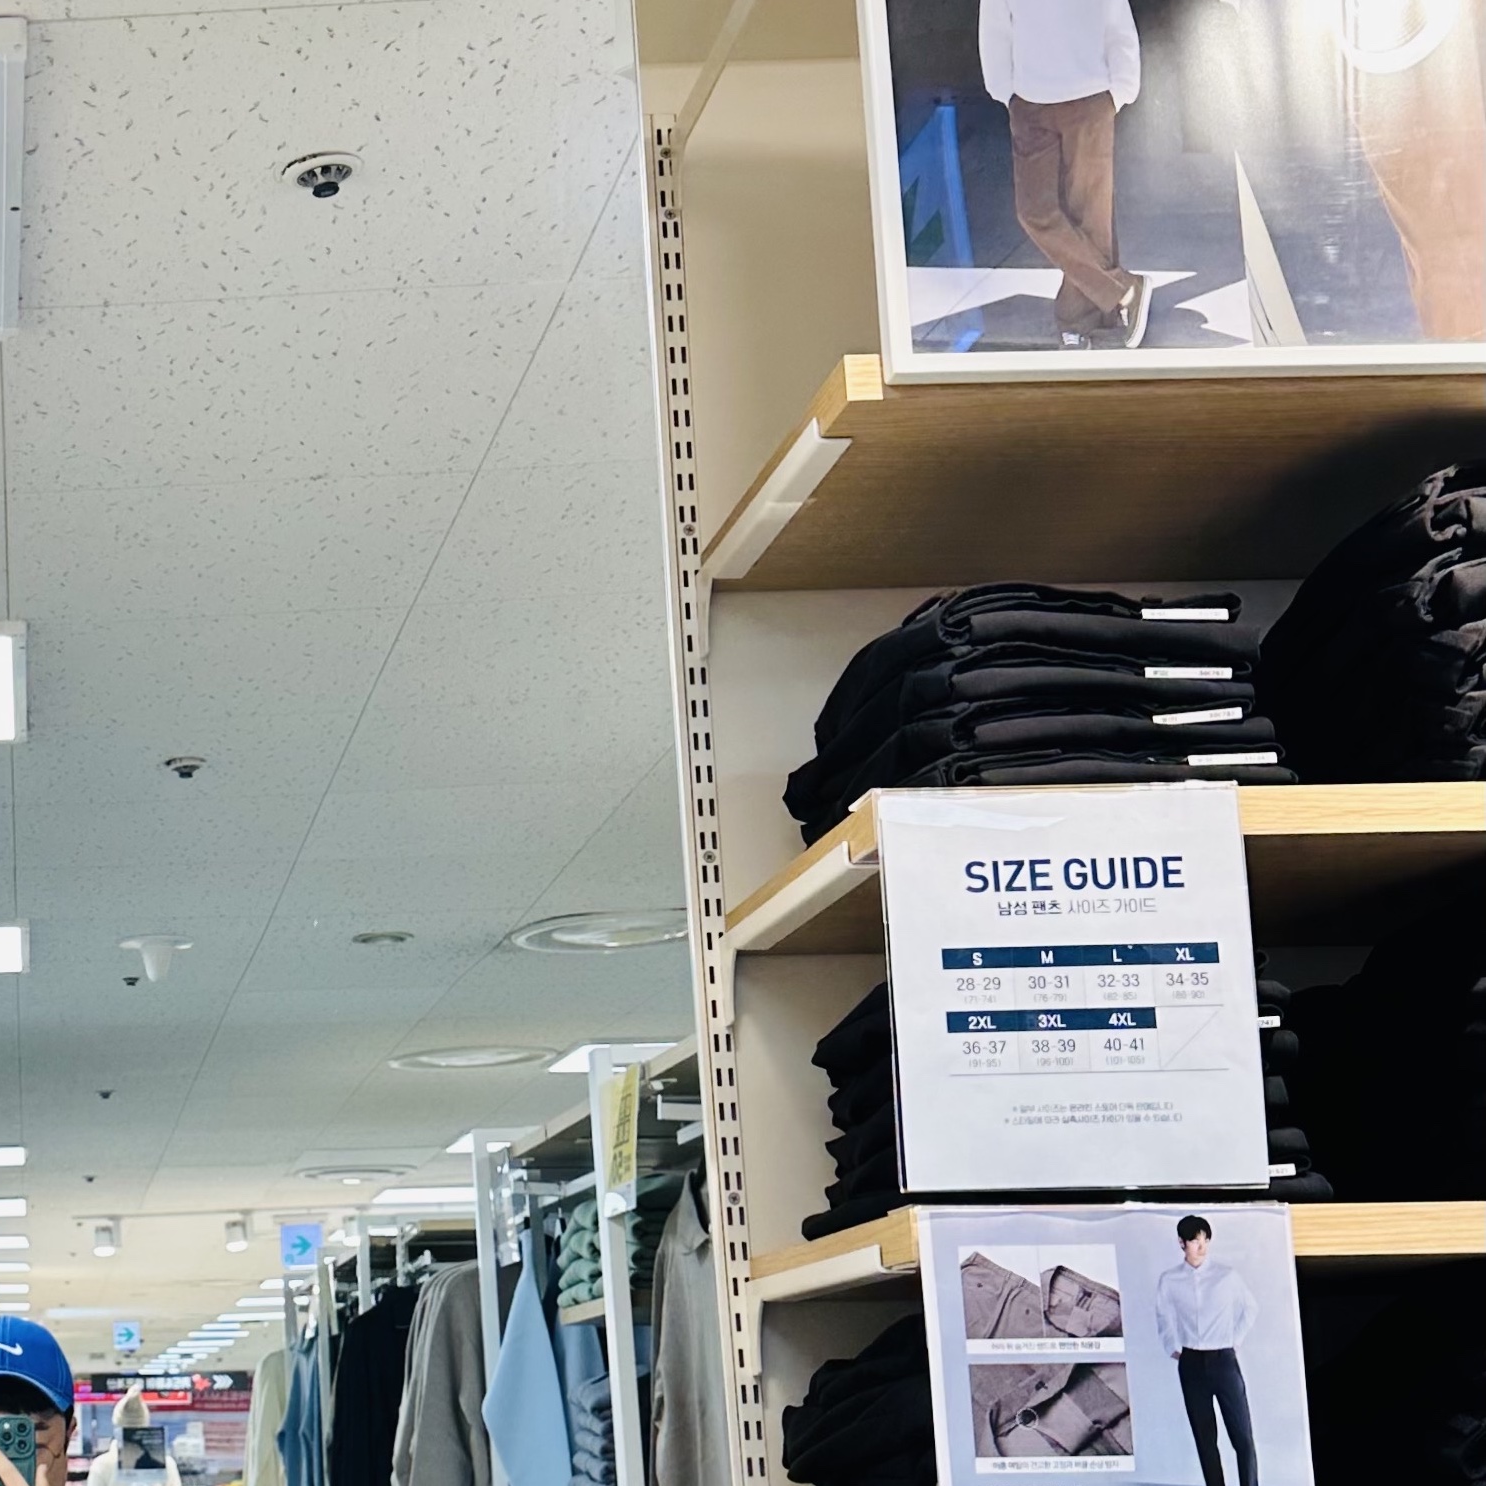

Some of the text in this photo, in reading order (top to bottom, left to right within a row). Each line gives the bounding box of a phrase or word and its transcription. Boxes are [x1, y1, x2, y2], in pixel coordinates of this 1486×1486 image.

[965, 856, 1185, 893] SIZE GUIDE
[998, 898, 1158, 916] 남성 팬츠 사이즈 가이드
[972, 952, 983, 965] S
[1041, 951, 1053, 964] M
[1113, 950, 1122, 962] L
[1176, 948, 1194, 961] XL
[956, 977, 1001, 991] 28-29
[1028, 975, 1070, 989] 30-31
[1097, 974, 1140, 988] 32-33
[1166, 972, 1209, 986] 34-35
[968, 1016, 997, 1030] 2XL
[1038, 1014, 1066, 1028] 3XL
[1109, 1013, 1136, 1026] 4XL
[962, 1040, 1006, 1054] 36-37
[1032, 1039, 1076, 1053] 38-39
[1104, 1038, 1144, 1052] 40-41
